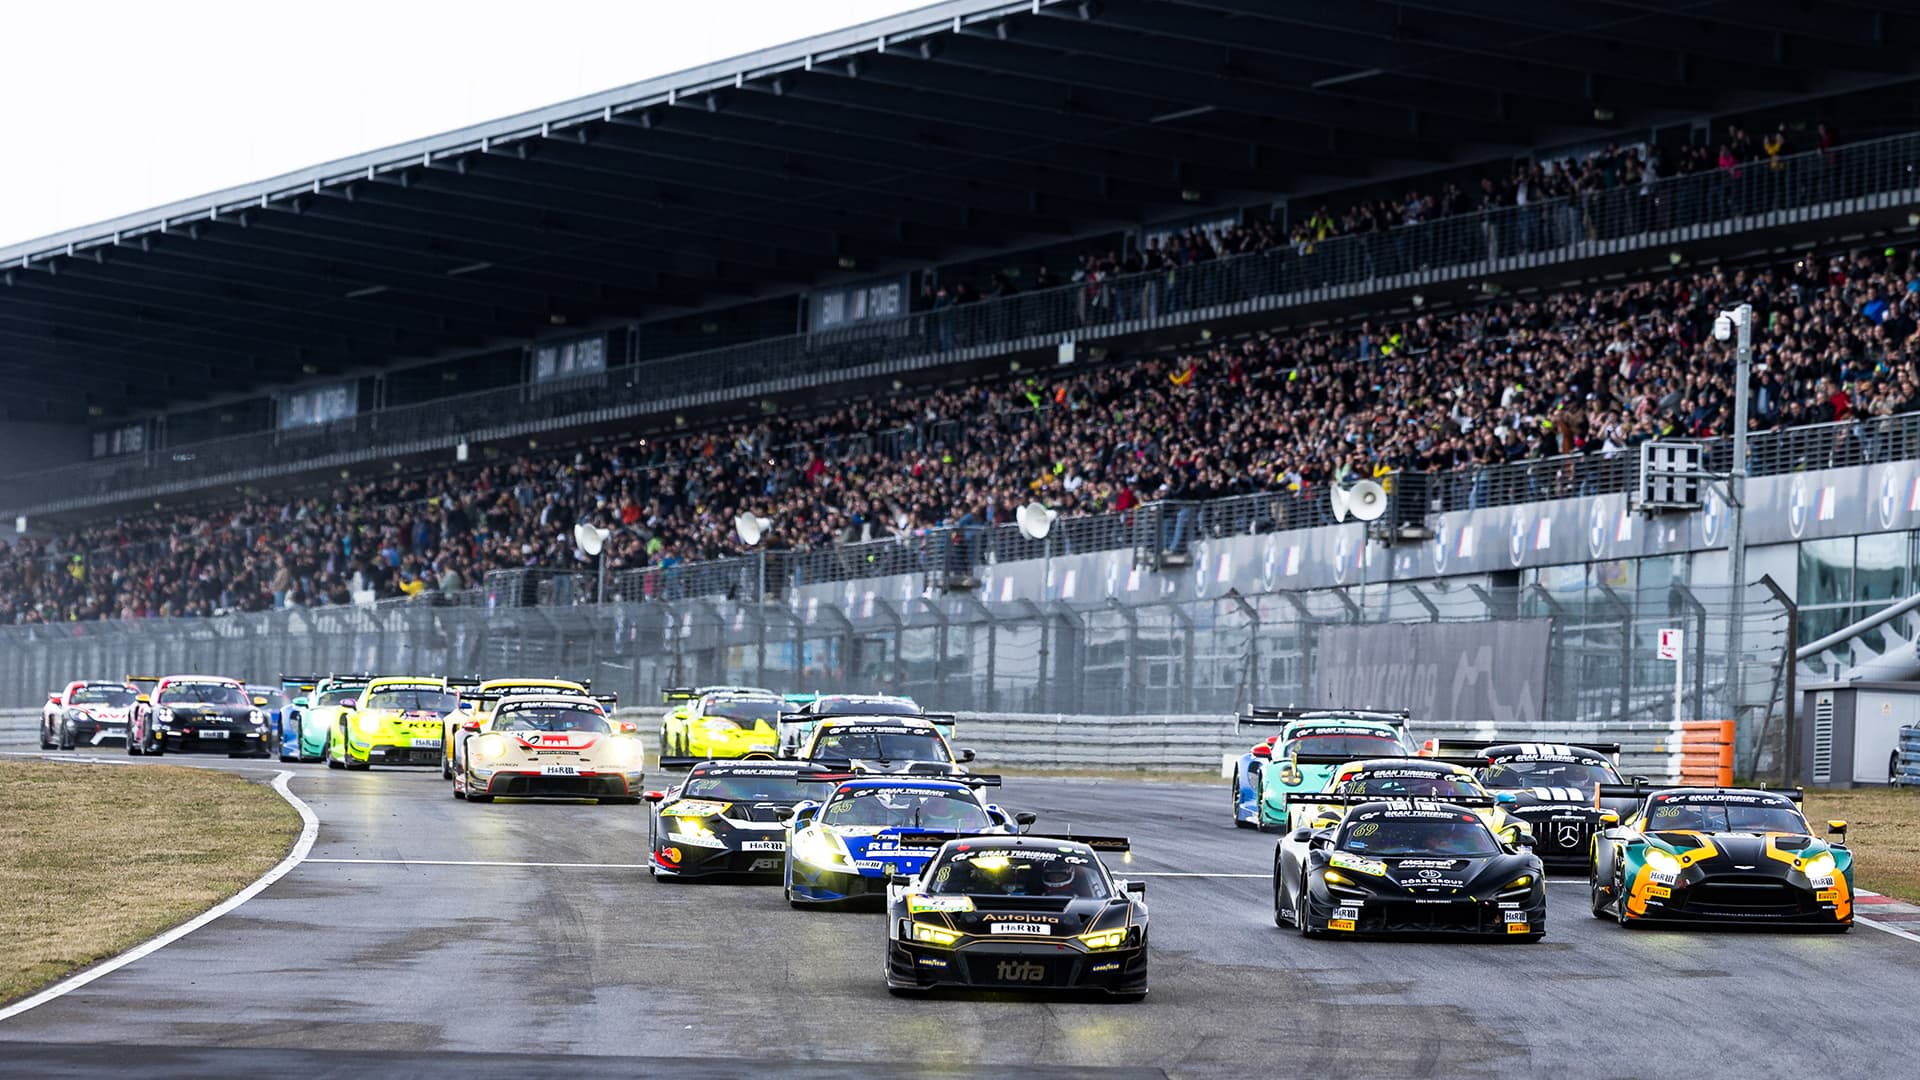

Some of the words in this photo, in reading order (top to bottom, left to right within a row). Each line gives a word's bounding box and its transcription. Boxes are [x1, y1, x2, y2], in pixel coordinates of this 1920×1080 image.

[1714, 795, 1756, 803] TURISMO
[1384, 810, 1411, 818] GRAN
[1411, 811, 1454, 819] TURISMO
[1656, 806, 1680, 818] 36
[1352, 822, 1379, 837] 69
[978, 850, 1010, 858] GRAN
[1010, 850, 1058, 860] TURISMO
[748, 858, 782, 872] ABT
[937, 866, 952, 883] 8
[982, 913, 1060, 924] Autojuta
[1001, 924, 1025, 932] H&R
